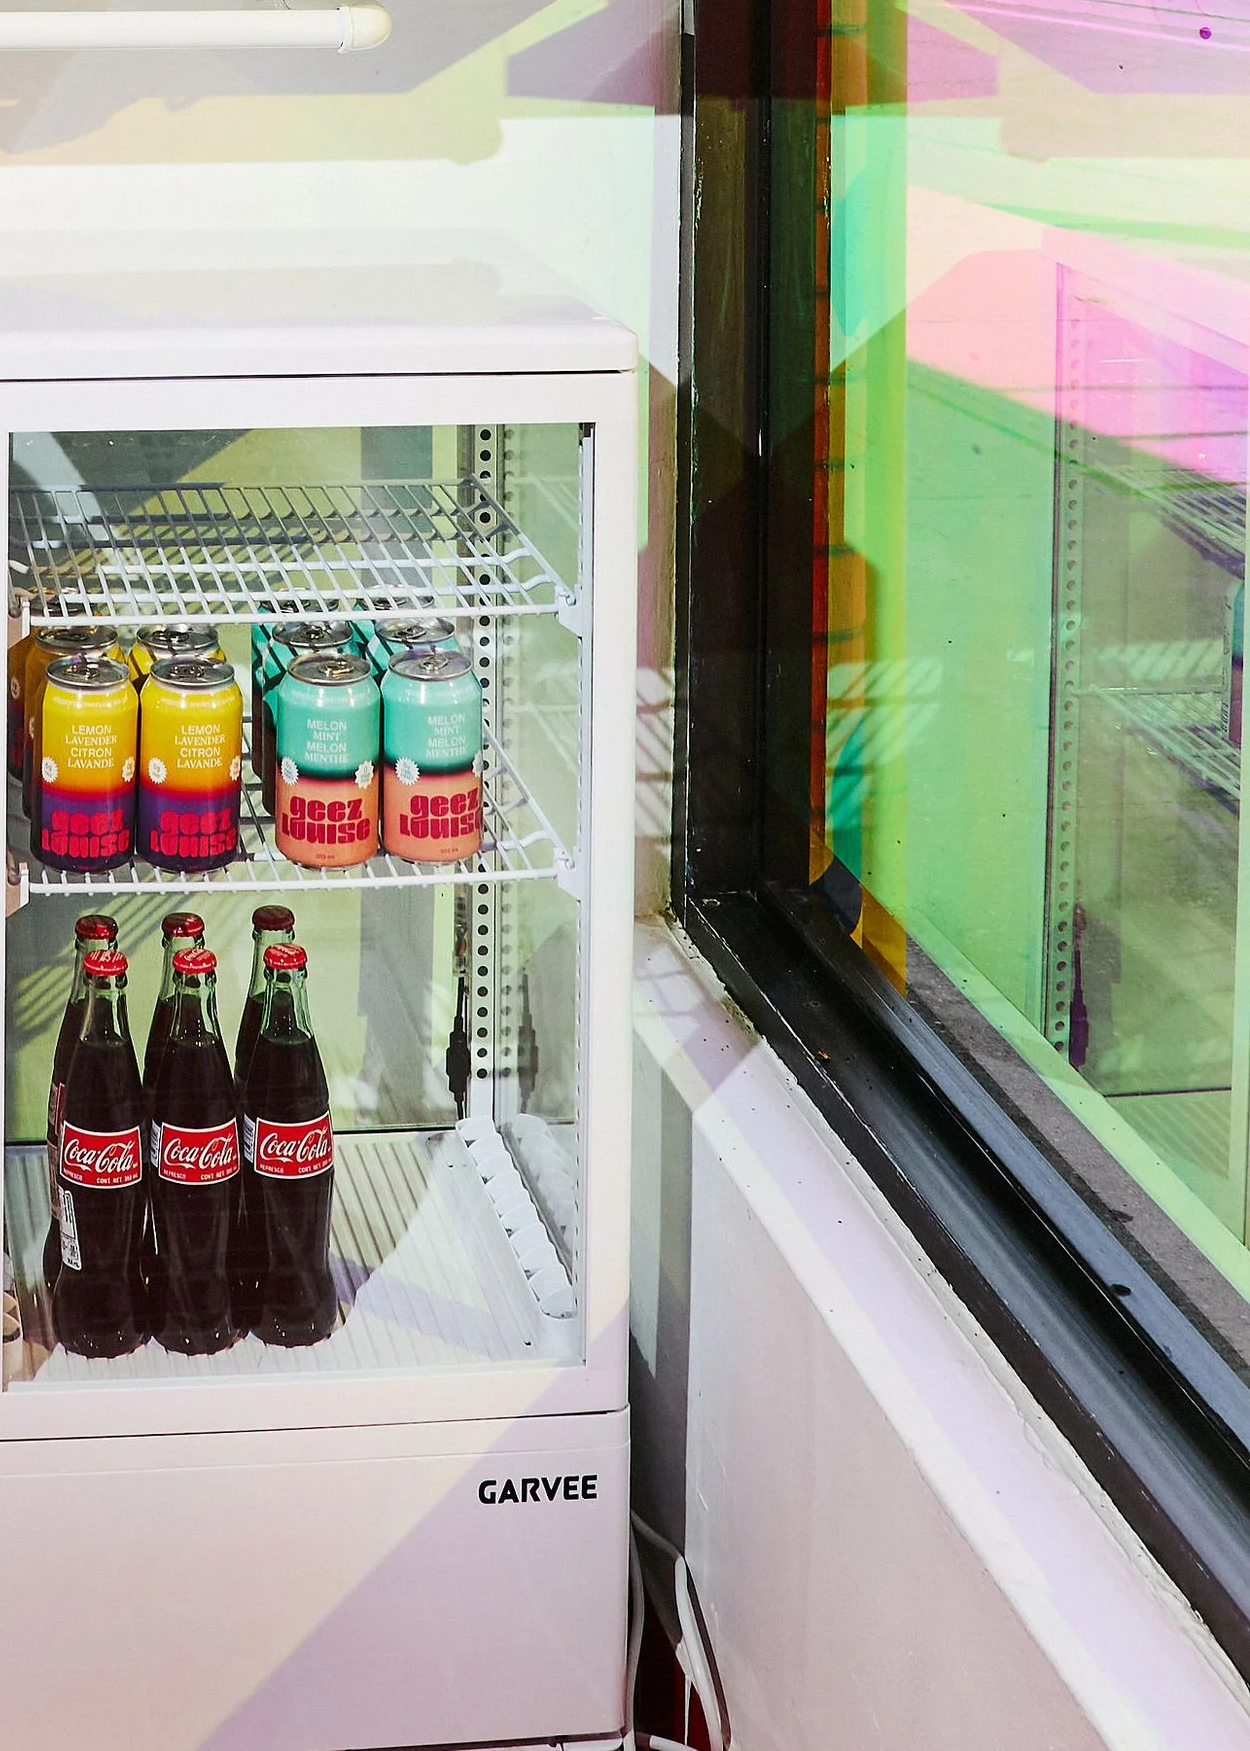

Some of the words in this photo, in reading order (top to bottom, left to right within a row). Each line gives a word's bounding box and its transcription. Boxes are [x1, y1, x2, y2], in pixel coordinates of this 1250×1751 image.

[306, 719, 348, 731] MELON
[427, 713, 466, 726] MELON
[71, 724, 112, 735] LEMON
[181, 724, 221, 735] LEMON
[434, 726, 461, 737] MINT
[65, 734, 118, 747] LAVENDER
[174, 734, 226, 747] LAVENDER
[312, 731, 342, 741] MINT
[306, 741, 348, 752] MELON
[427, 736, 466, 749] MELON
[70, 747, 112, 758] CITRON
[179, 747, 221, 758] CITRON
[304, 752, 349, 764] MENTHE
[67, 757, 115, 769] LAVANDE
[176, 757, 223, 769] LAVANDE
[289, 795, 363, 823] geez
[410, 787, 479, 821] geez
[259, 1125, 330, 1164] Coca-Cola
[63, 1137, 136, 1174] Coca-Cola
[163, 1133, 234, 1170] Coca-Cola
[478, 1474, 598, 1505] GARVEE
